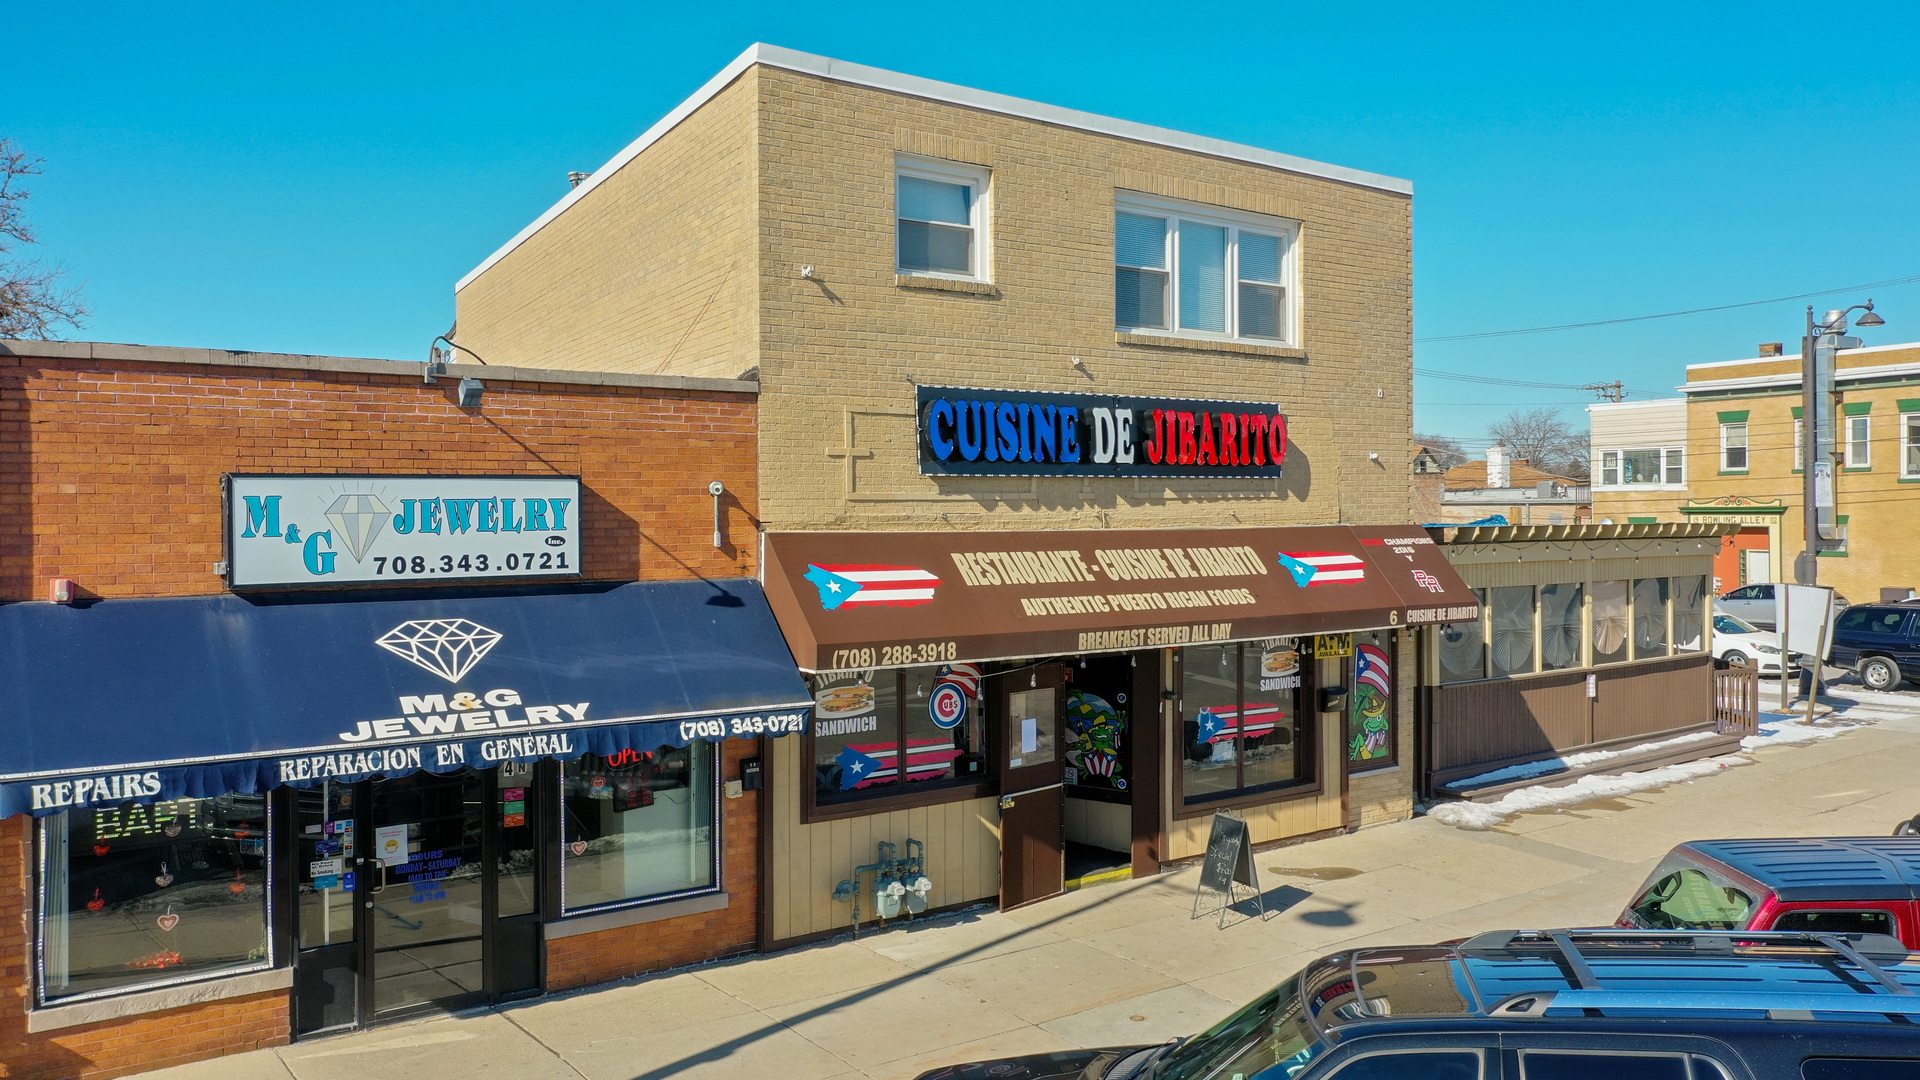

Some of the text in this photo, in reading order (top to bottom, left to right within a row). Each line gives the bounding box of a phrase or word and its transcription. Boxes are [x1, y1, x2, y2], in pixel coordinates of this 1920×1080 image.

[930, 398, 1287, 467] CUISINE DE JIBARITO
[1702, 515, 1737, 524] BOWLING
[1740, 516, 1766, 524] ALLEY
[241, 495, 571, 575] M & G JEWELRY
[548, 537, 564, 545] Inc.
[1384, 537, 1434, 545] CHAMPIONS
[373, 552, 569, 575] 708.343.0721
[951, 550, 1095, 586] RESTAURANTE
[1095, 548, 1176, 581] CUISINE
[1162, 548, 1199, 578] DE
[1186, 545, 1268, 577] JIBARITO
[1021, 588, 1256, 616] AUTHENTIC PUERTO RICAN FOODS
[1406, 606, 1478, 623] CUISINE DE JIBARITO
[1389, 610, 1398, 625] 6
[1079, 623, 1232, 650] BREAKFAST SERVED ALL DAY
[833, 641, 957, 669] (708) 288-3918
[1260, 676, 1300, 692] SANDWICH
[399, 688, 522, 714] M&G
[339, 702, 590, 742] JEWELRY
[680, 714, 803, 740] (708) 343-0721
[815, 716, 877, 738] SANDWICH
[279, 747, 422, 782] REPARACION
[436, 743, 466, 765] EN
[31, 771, 162, 810] REPAIRS
